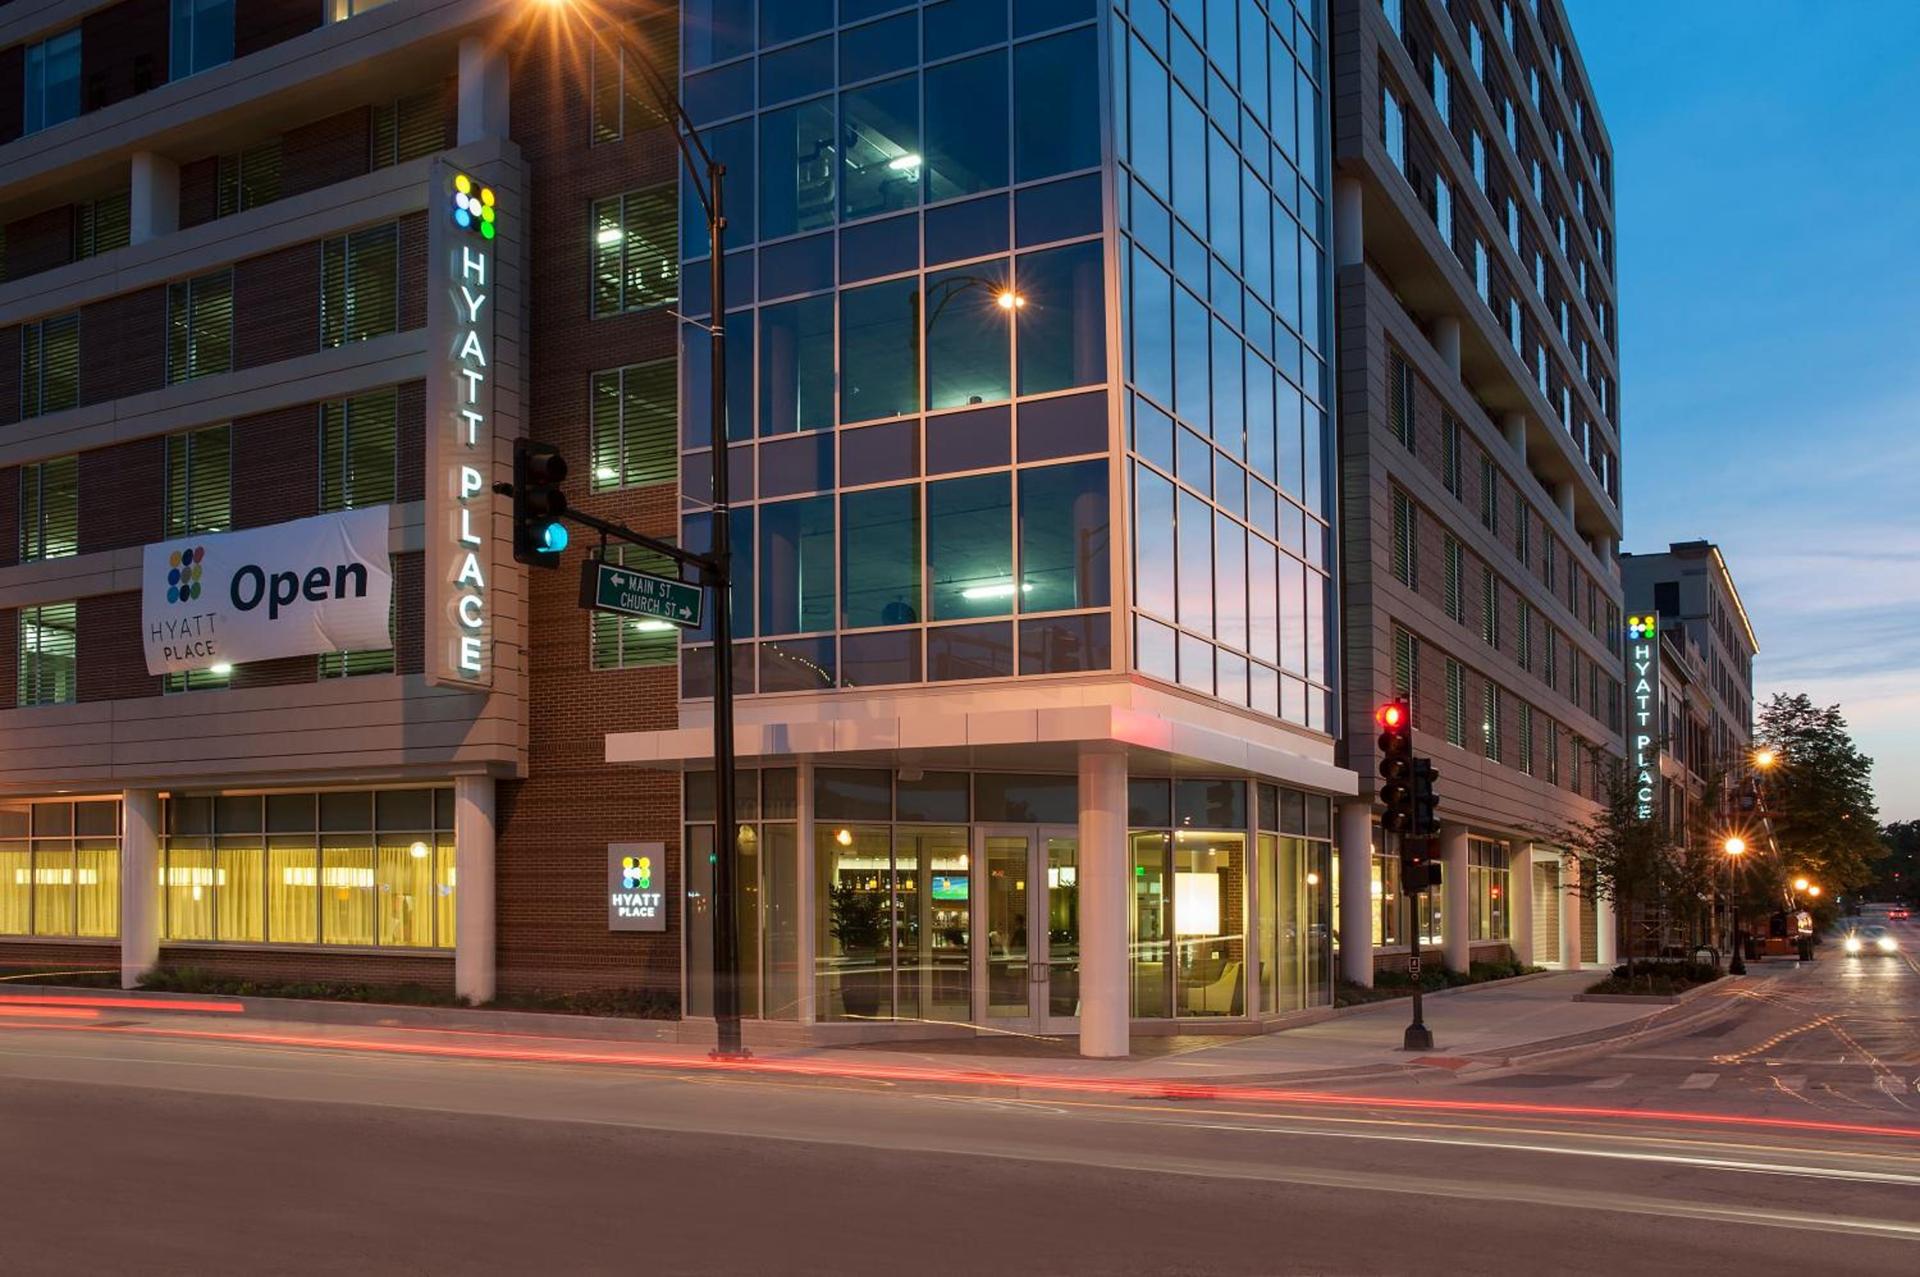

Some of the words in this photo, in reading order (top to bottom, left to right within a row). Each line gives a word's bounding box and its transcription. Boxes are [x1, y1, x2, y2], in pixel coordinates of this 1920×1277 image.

[460, 246, 487, 445] HYATT
[458, 466, 485, 672] PLACE
[230, 562, 369, 620] Open
[628, 576, 655, 595] MAIN
[620, 592, 660, 614] CHURCH
[151, 612, 217, 643] HYATT
[164, 640, 216, 661] PLACE
[1635, 645, 1652, 727] HYATT
[1637, 735, 1652, 820] PLACE
[612, 893, 660, 906] HYATT
[618, 906, 655, 917] PLACE
